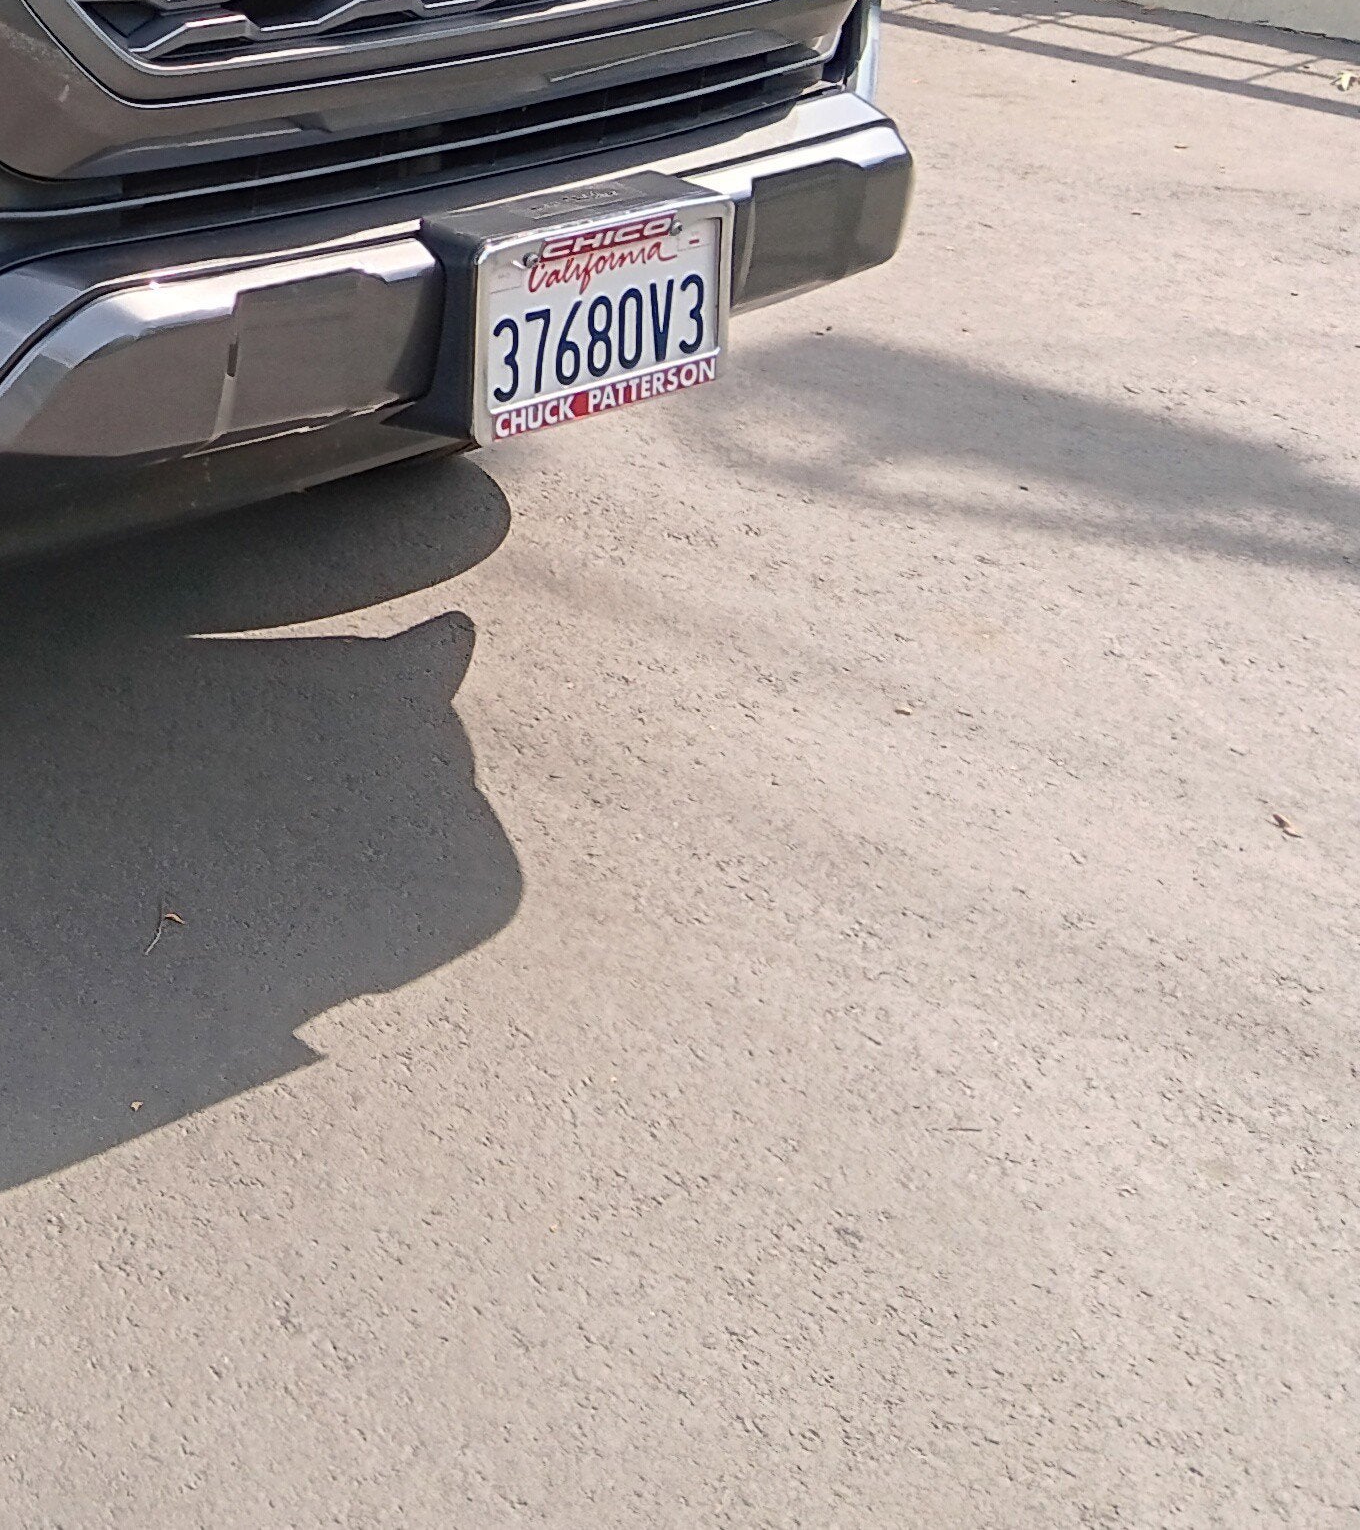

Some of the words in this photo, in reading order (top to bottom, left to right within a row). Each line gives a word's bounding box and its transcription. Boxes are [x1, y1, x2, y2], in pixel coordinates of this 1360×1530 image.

[528, 241, 678, 294] California
[543, 217, 673, 259] CHICO
[493, 273, 705, 403] 37680V3
[495, 395, 575, 438] CHUCK
[588, 359, 716, 413] PATTERSON
